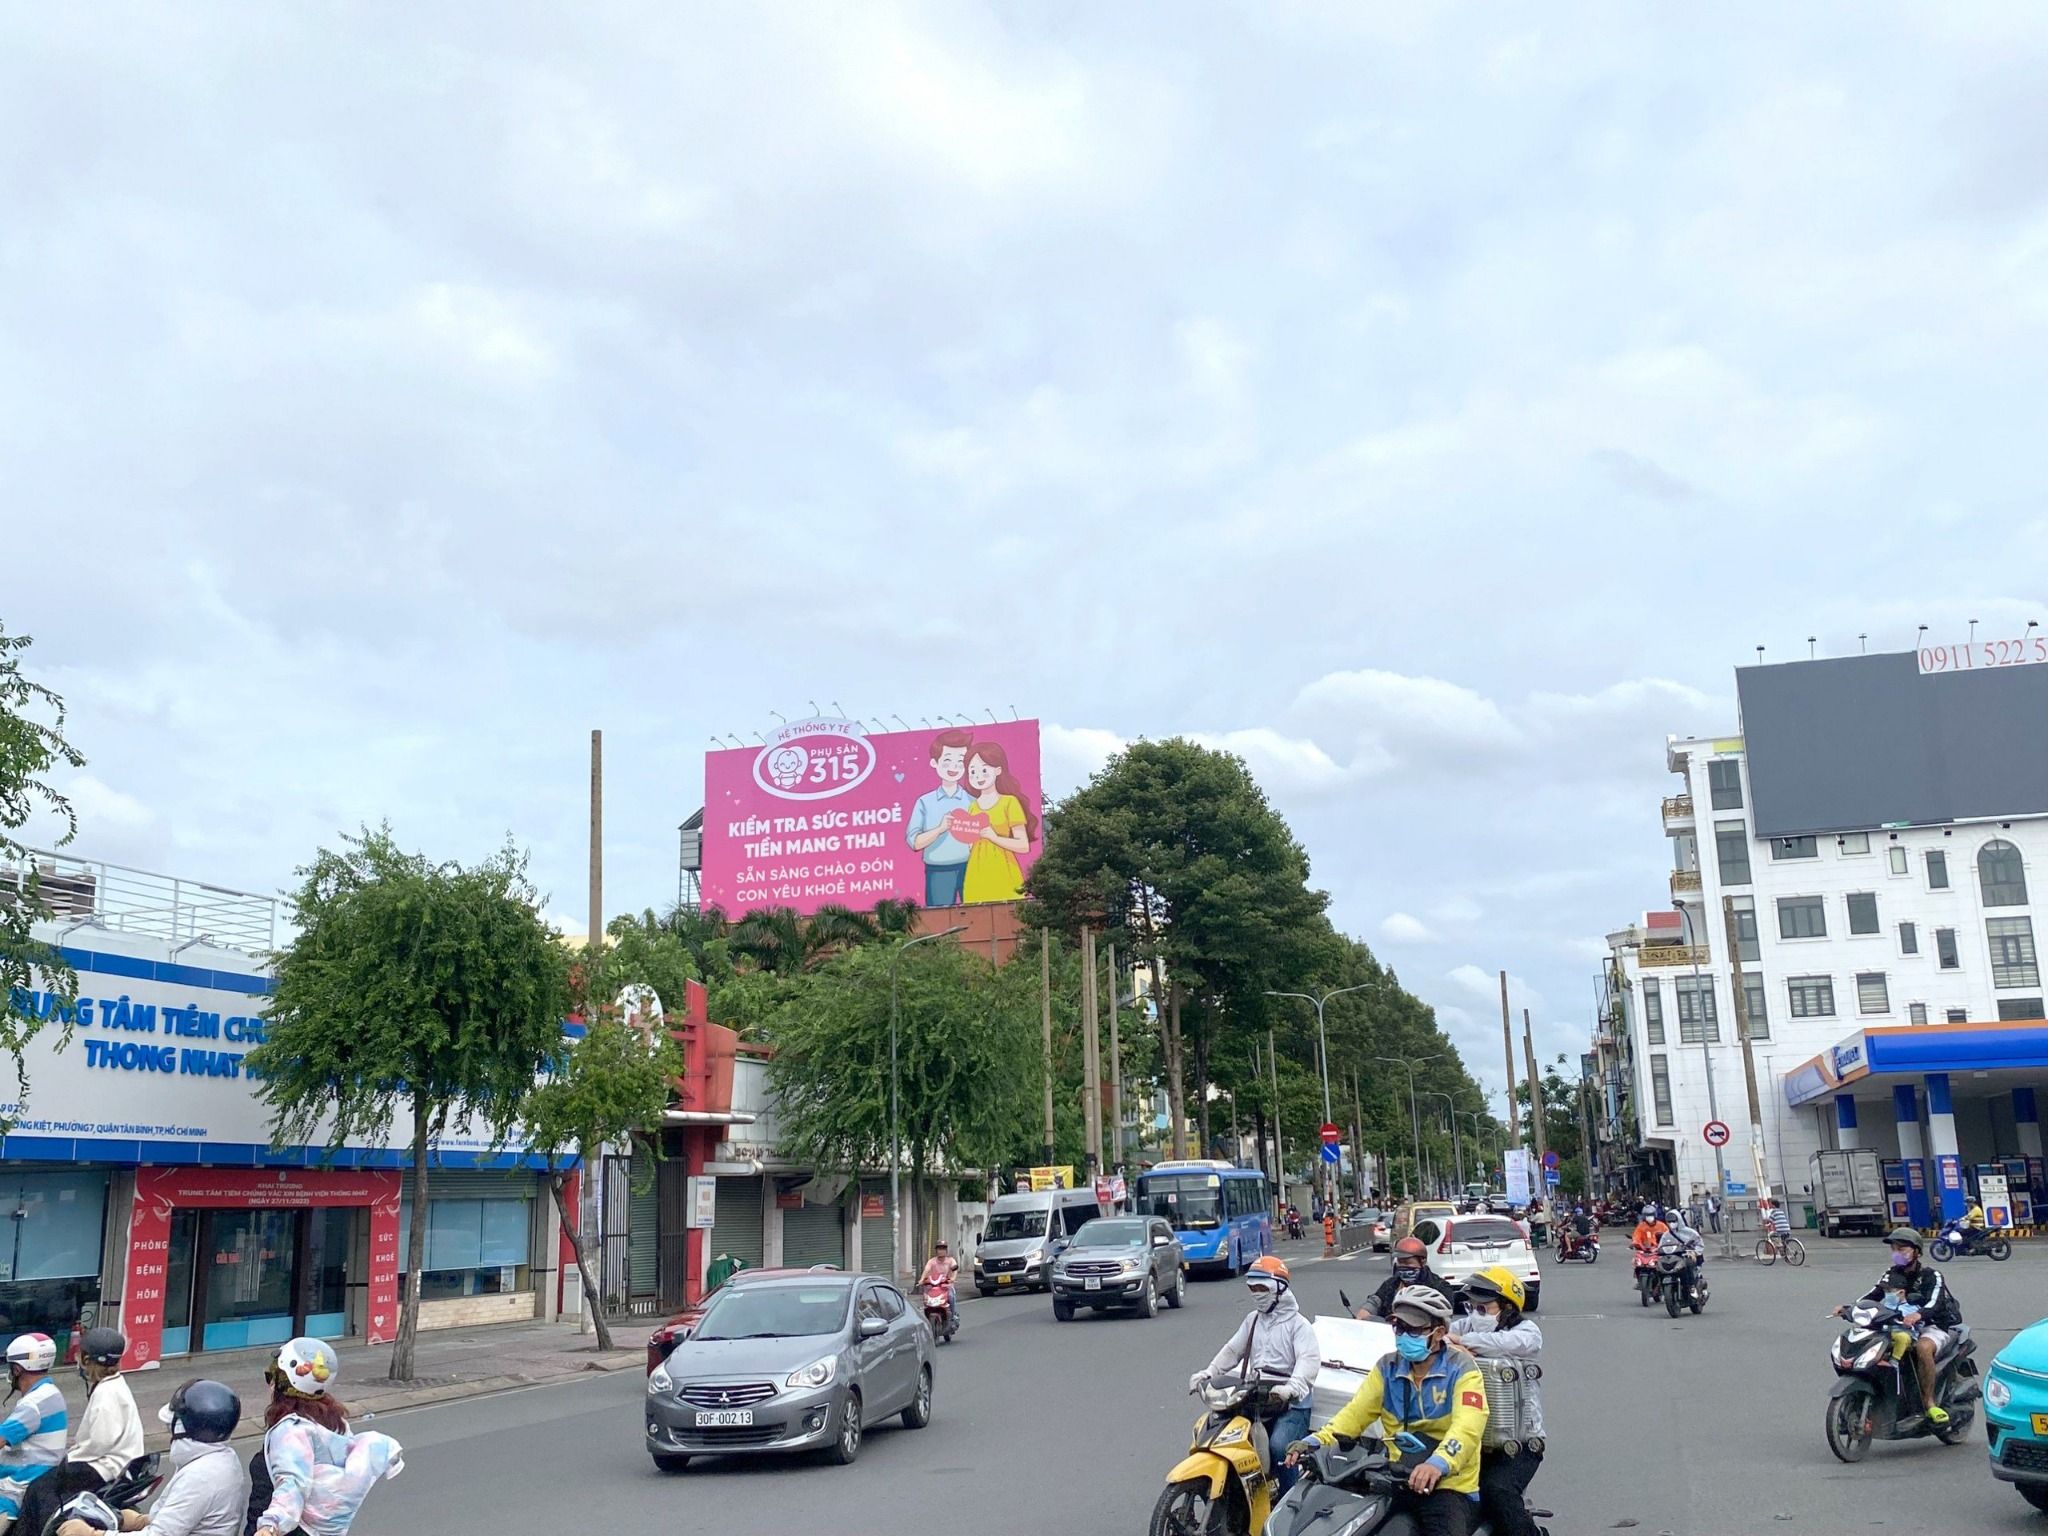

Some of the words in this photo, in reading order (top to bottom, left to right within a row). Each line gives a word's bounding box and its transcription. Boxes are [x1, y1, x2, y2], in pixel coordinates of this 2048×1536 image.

[1921, 645, 1973, 672] 0911
[1984, 640, 2026, 666] 522
[778, 729, 791, 740] HỆ
[793, 721, 826, 735] THỐNG
[838, 724, 851, 734] TẾ
[810, 747, 832, 758] PHỤ
[836, 743, 859, 754] SẢN
[809, 754, 859, 783] 315
[728, 814, 770, 837] KIỂM
[774, 816, 808, 833] TRA
[811, 810, 848, 830] SỨC
[744, 836, 782, 858] TIỀN
[786, 836, 840, 855] MANG
[844, 831, 885, 850] THAI
[770, 865, 810, 881] SÀNG
[814, 861, 856, 877] CHÀO
[860, 857, 894, 873] ĐÓN
[736, 890, 767, 902] CON
[772, 886, 800, 899] YÊU
[850, 878, 893, 895] MẠNH
[99, 995, 156, 1032] TÂM
[134, 1240, 168, 1250] PHÒNG
[136, 1264, 162, 1275] BỆNH
[136, 1288, 159, 1299] HÔM
[377, 1294, 391, 1303] MAI
[135, 1314, 155, 1324] NAY
